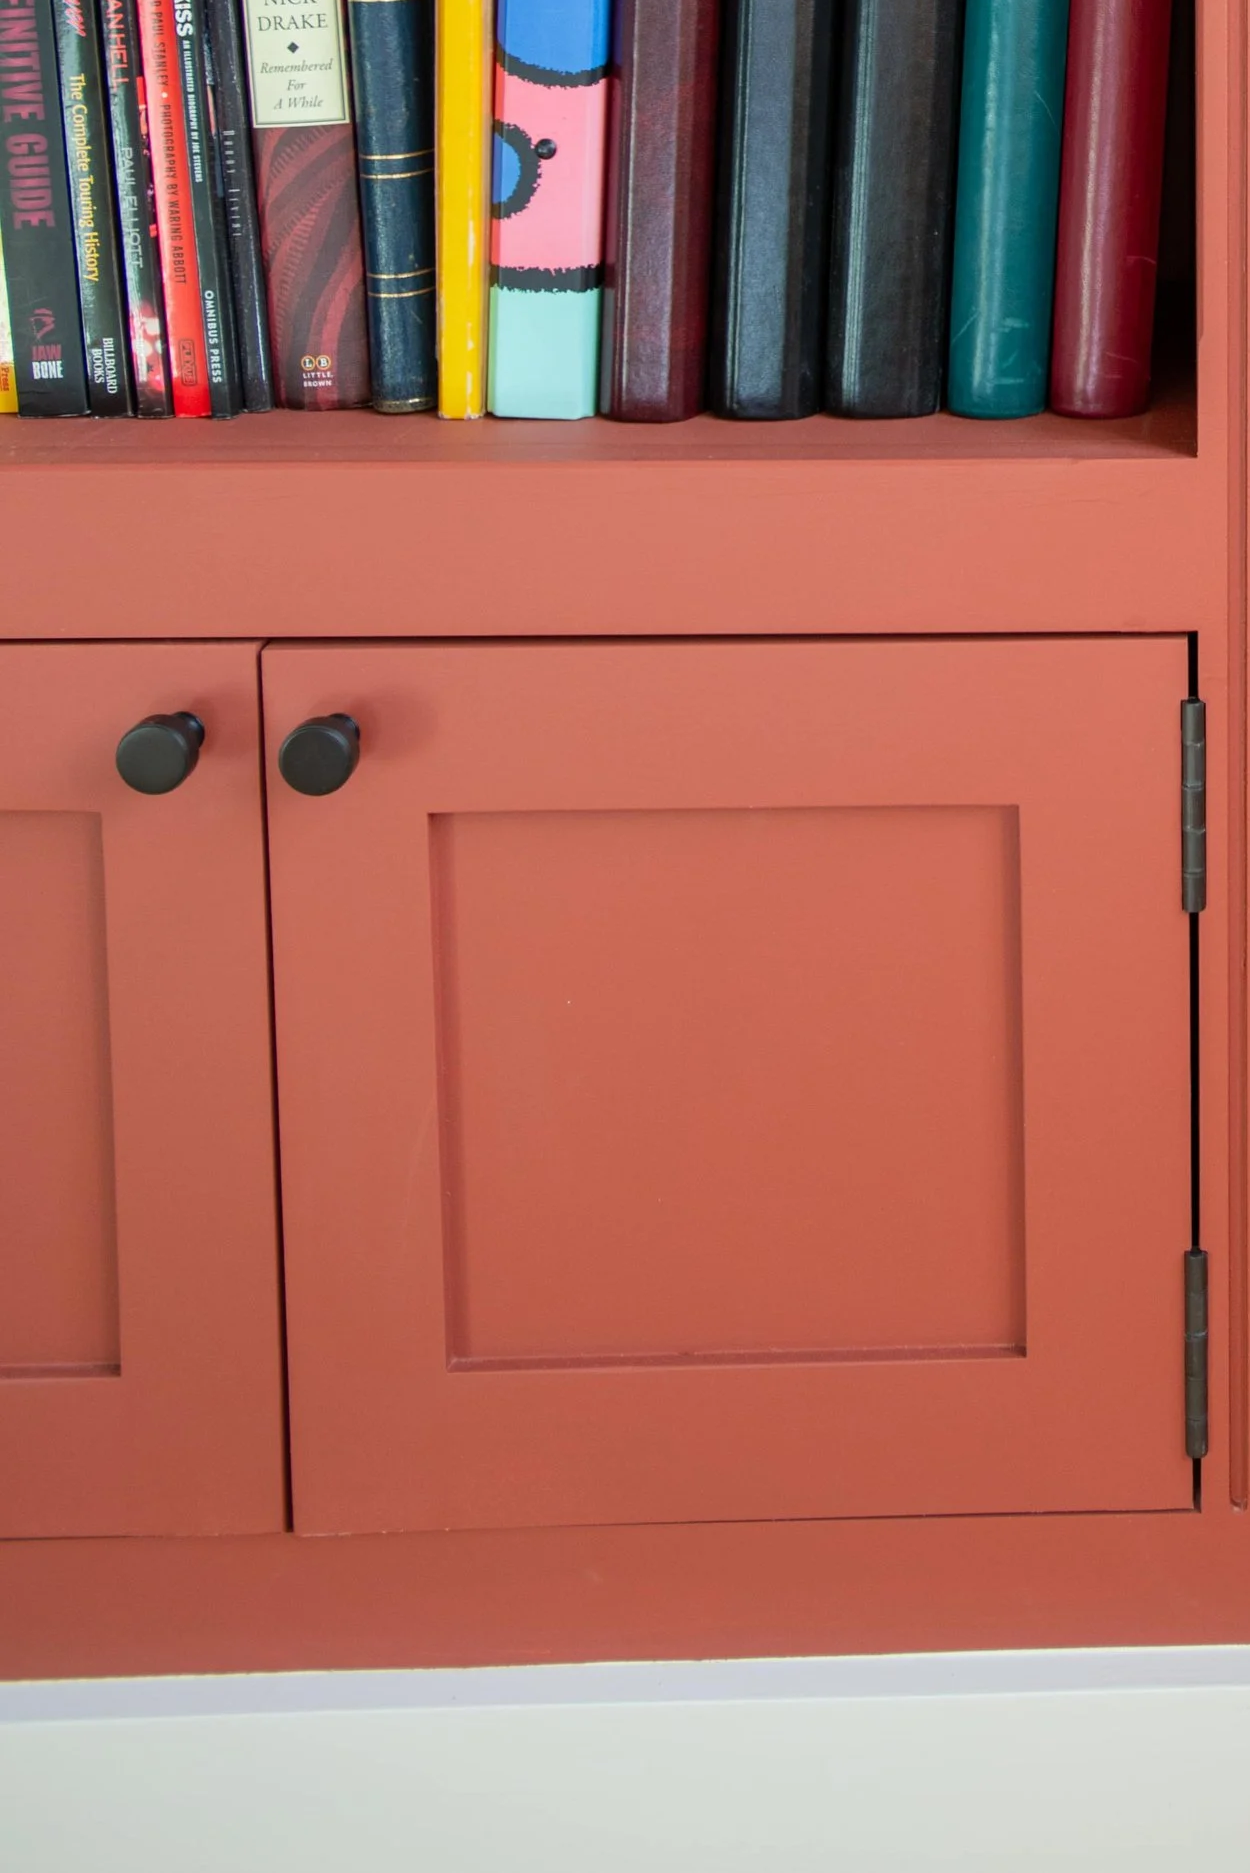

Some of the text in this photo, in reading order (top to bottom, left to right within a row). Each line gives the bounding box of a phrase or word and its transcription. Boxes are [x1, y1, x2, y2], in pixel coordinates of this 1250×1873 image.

[257, 12, 329, 33] DRAKE
[259, 58, 334, 75] Remembered
[6, 133, 55, 230] GUIDE
[68, 73, 99, 282] The Complete Touring History
[100, 337, 118, 395] BILLBOARD
[204, 290, 222, 384] OMNIBUS PRESS
[32, 360, 63, 380] BONE
